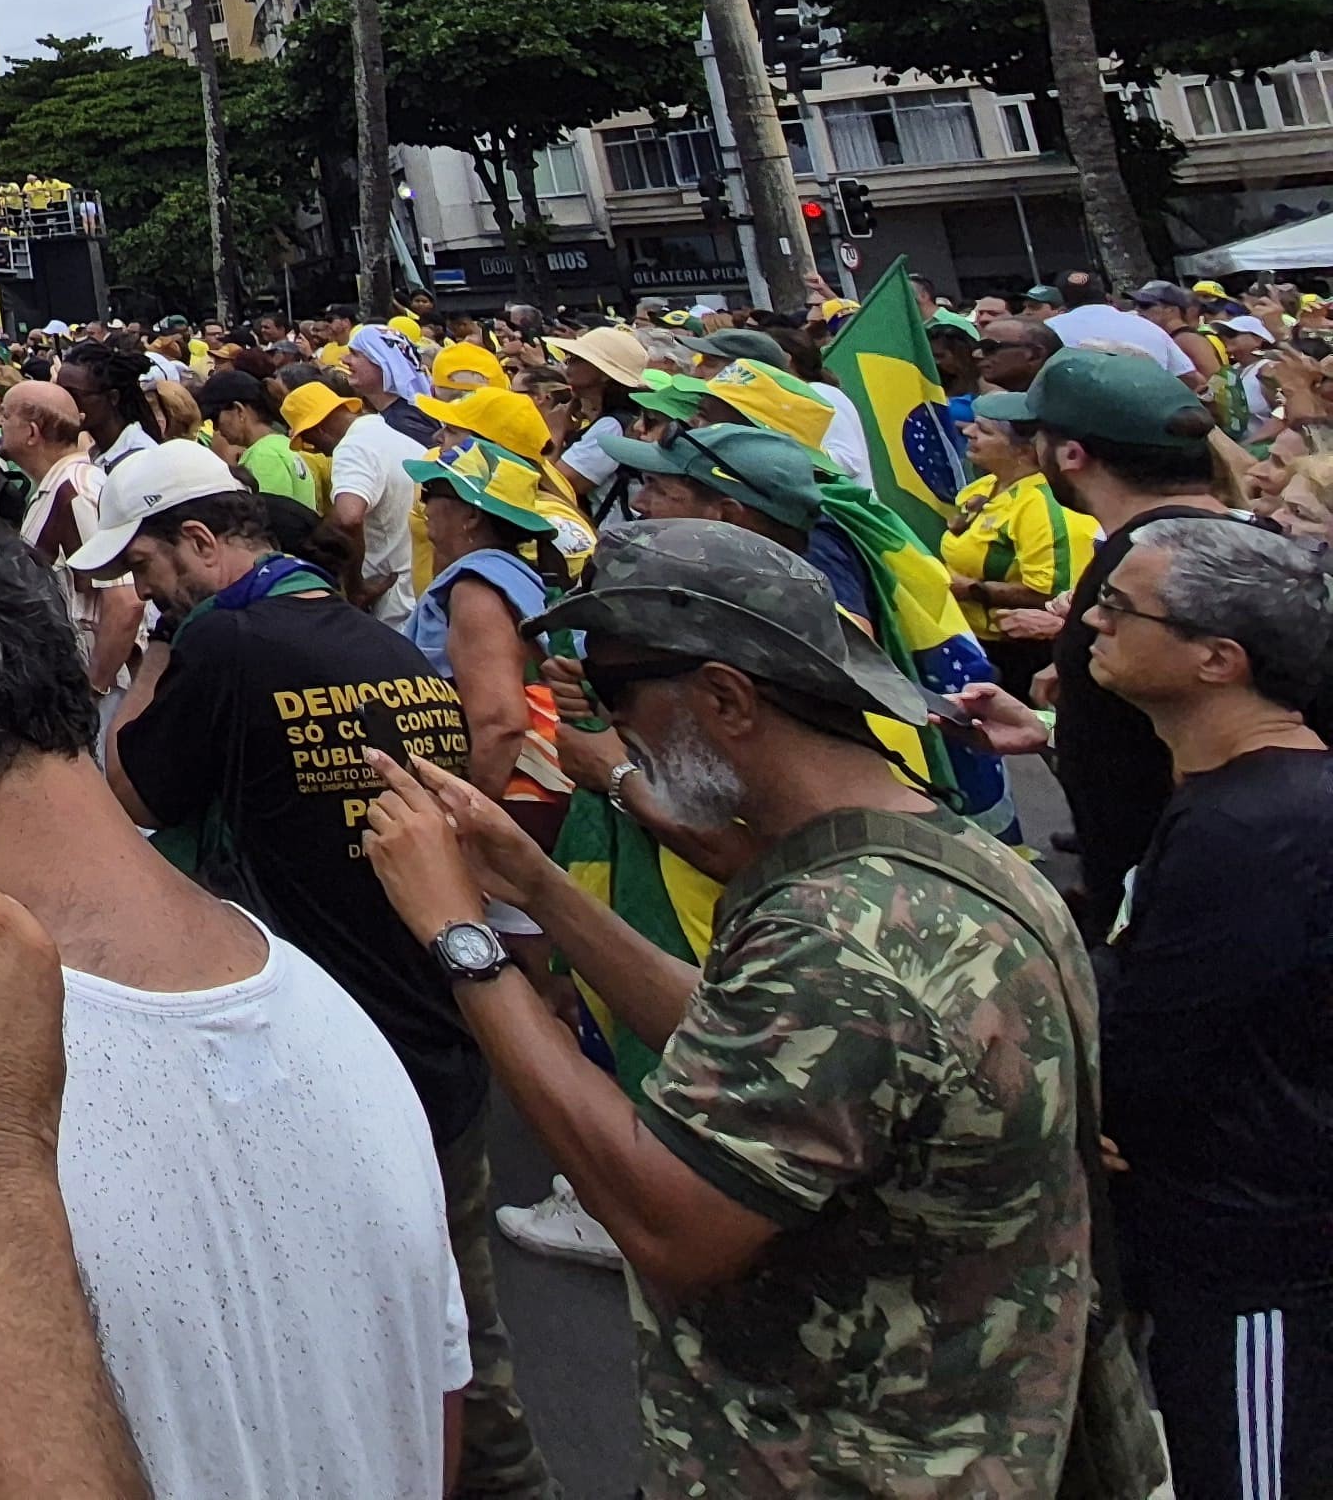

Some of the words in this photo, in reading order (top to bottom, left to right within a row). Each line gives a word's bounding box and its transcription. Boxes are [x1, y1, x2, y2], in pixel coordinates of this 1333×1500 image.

[273, 675, 463, 720] DEMOCRACIA
[286, 720, 325, 745] SÓ
[295, 769, 359, 785] PROJETO
